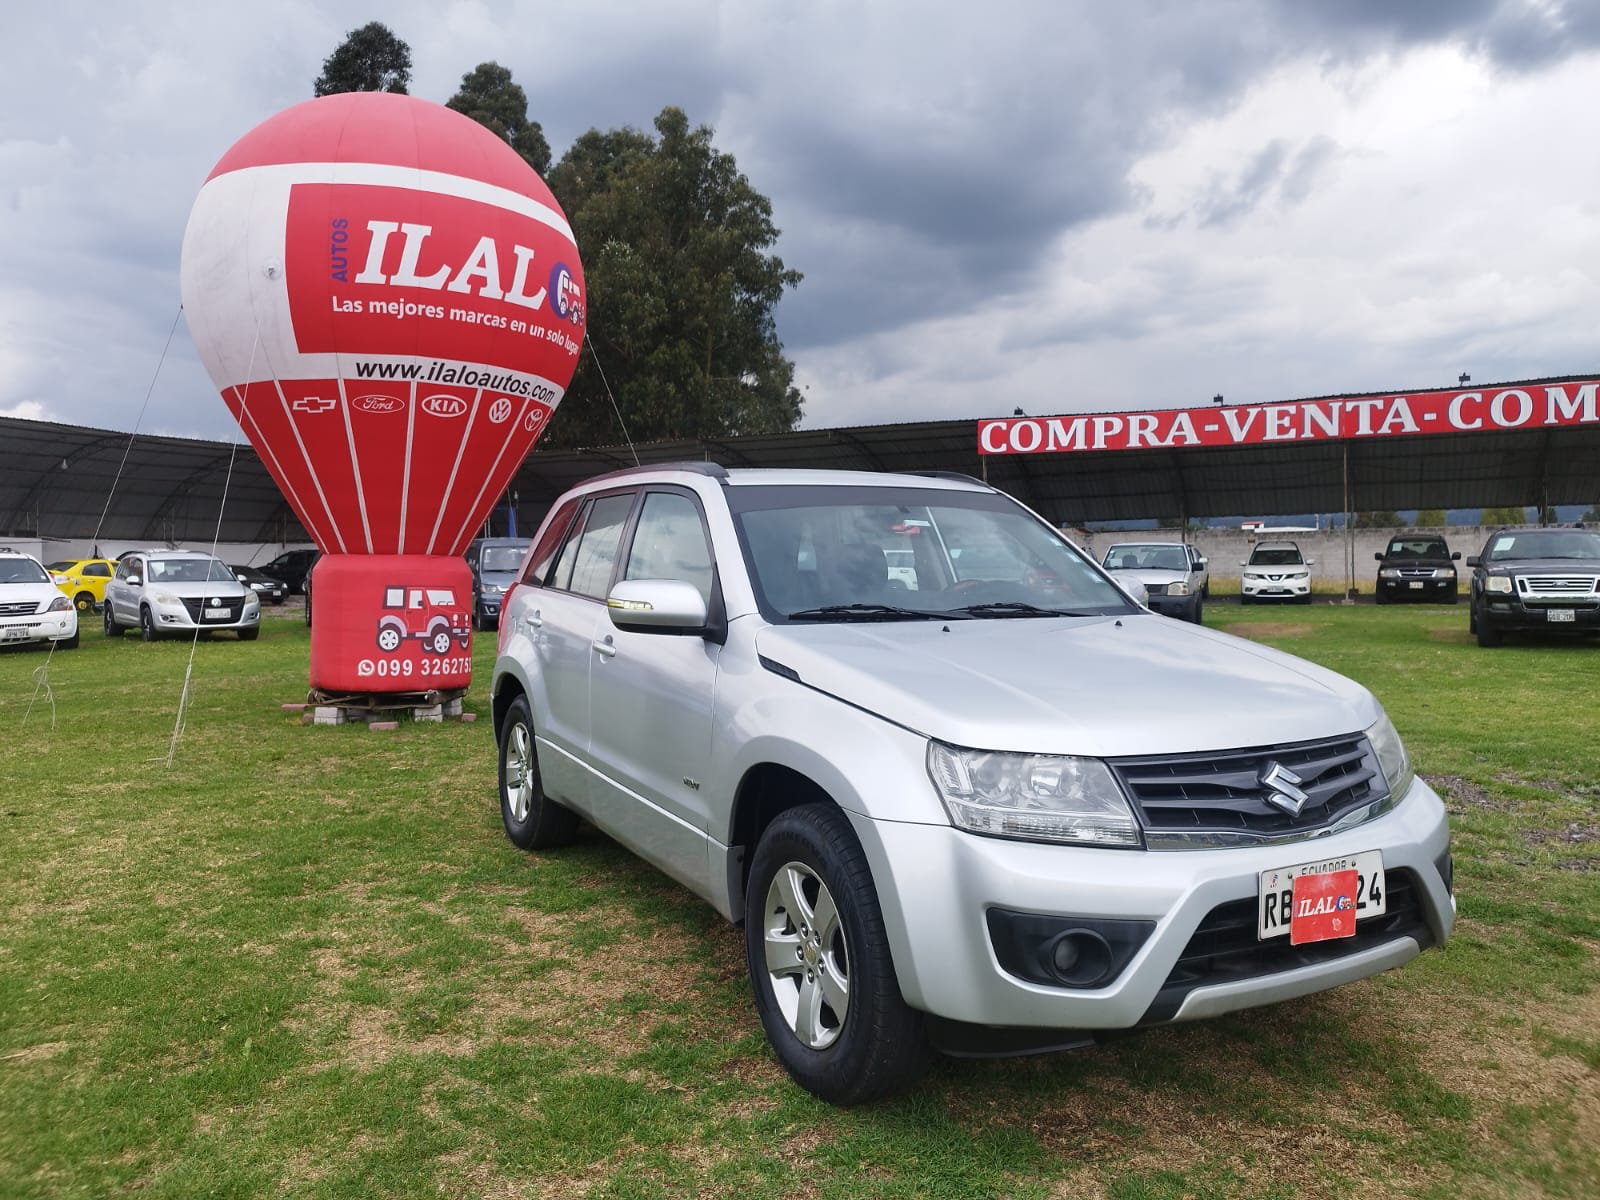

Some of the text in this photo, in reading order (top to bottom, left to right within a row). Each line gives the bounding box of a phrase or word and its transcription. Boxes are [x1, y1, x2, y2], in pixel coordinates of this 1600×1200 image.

[330, 218, 348, 283] AUTOS
[332, 295, 580, 357] Las mejores marcas en un solo lugar
[355, 361, 556, 404] www.ilaloautos.com
[362, 397, 394, 410] Ford
[429, 398, 460, 414] KIA
[377, 658, 413, 677] 099
